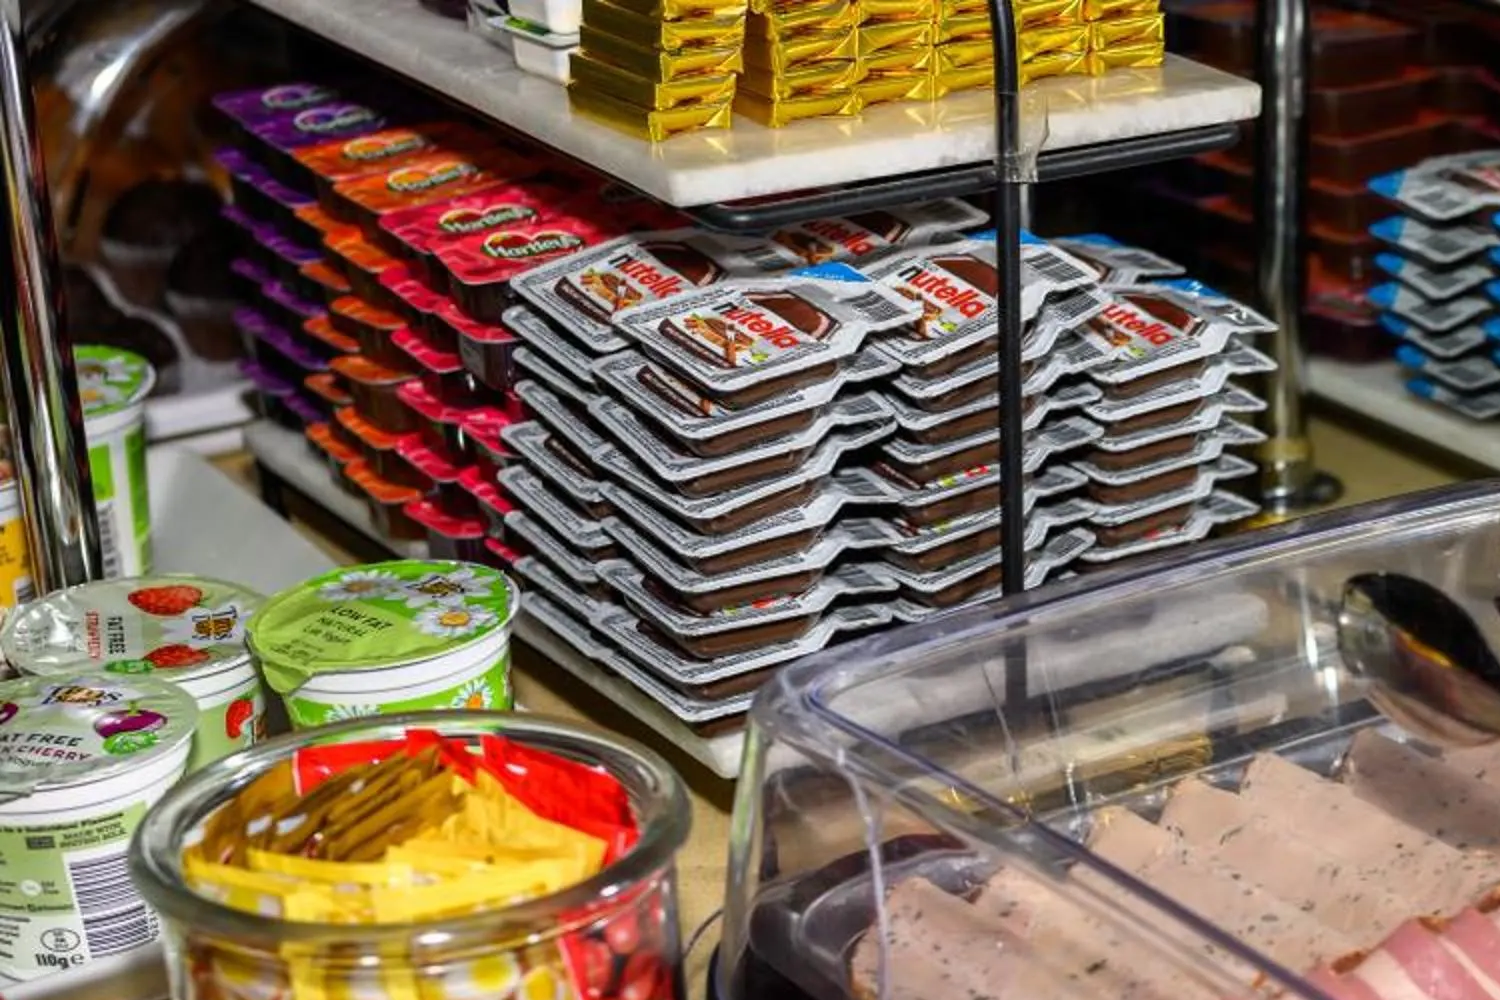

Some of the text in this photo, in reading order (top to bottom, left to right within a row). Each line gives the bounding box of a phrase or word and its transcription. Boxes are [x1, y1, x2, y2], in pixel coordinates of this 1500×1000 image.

[897, 265, 986, 318] nutella
[711, 301, 801, 349] nutella
[1102, 302, 1174, 347] utella
[16, 745, 93, 761] CHERRY
[26, 732, 84, 747] FREE
[35, 953, 69, 970] 110g
